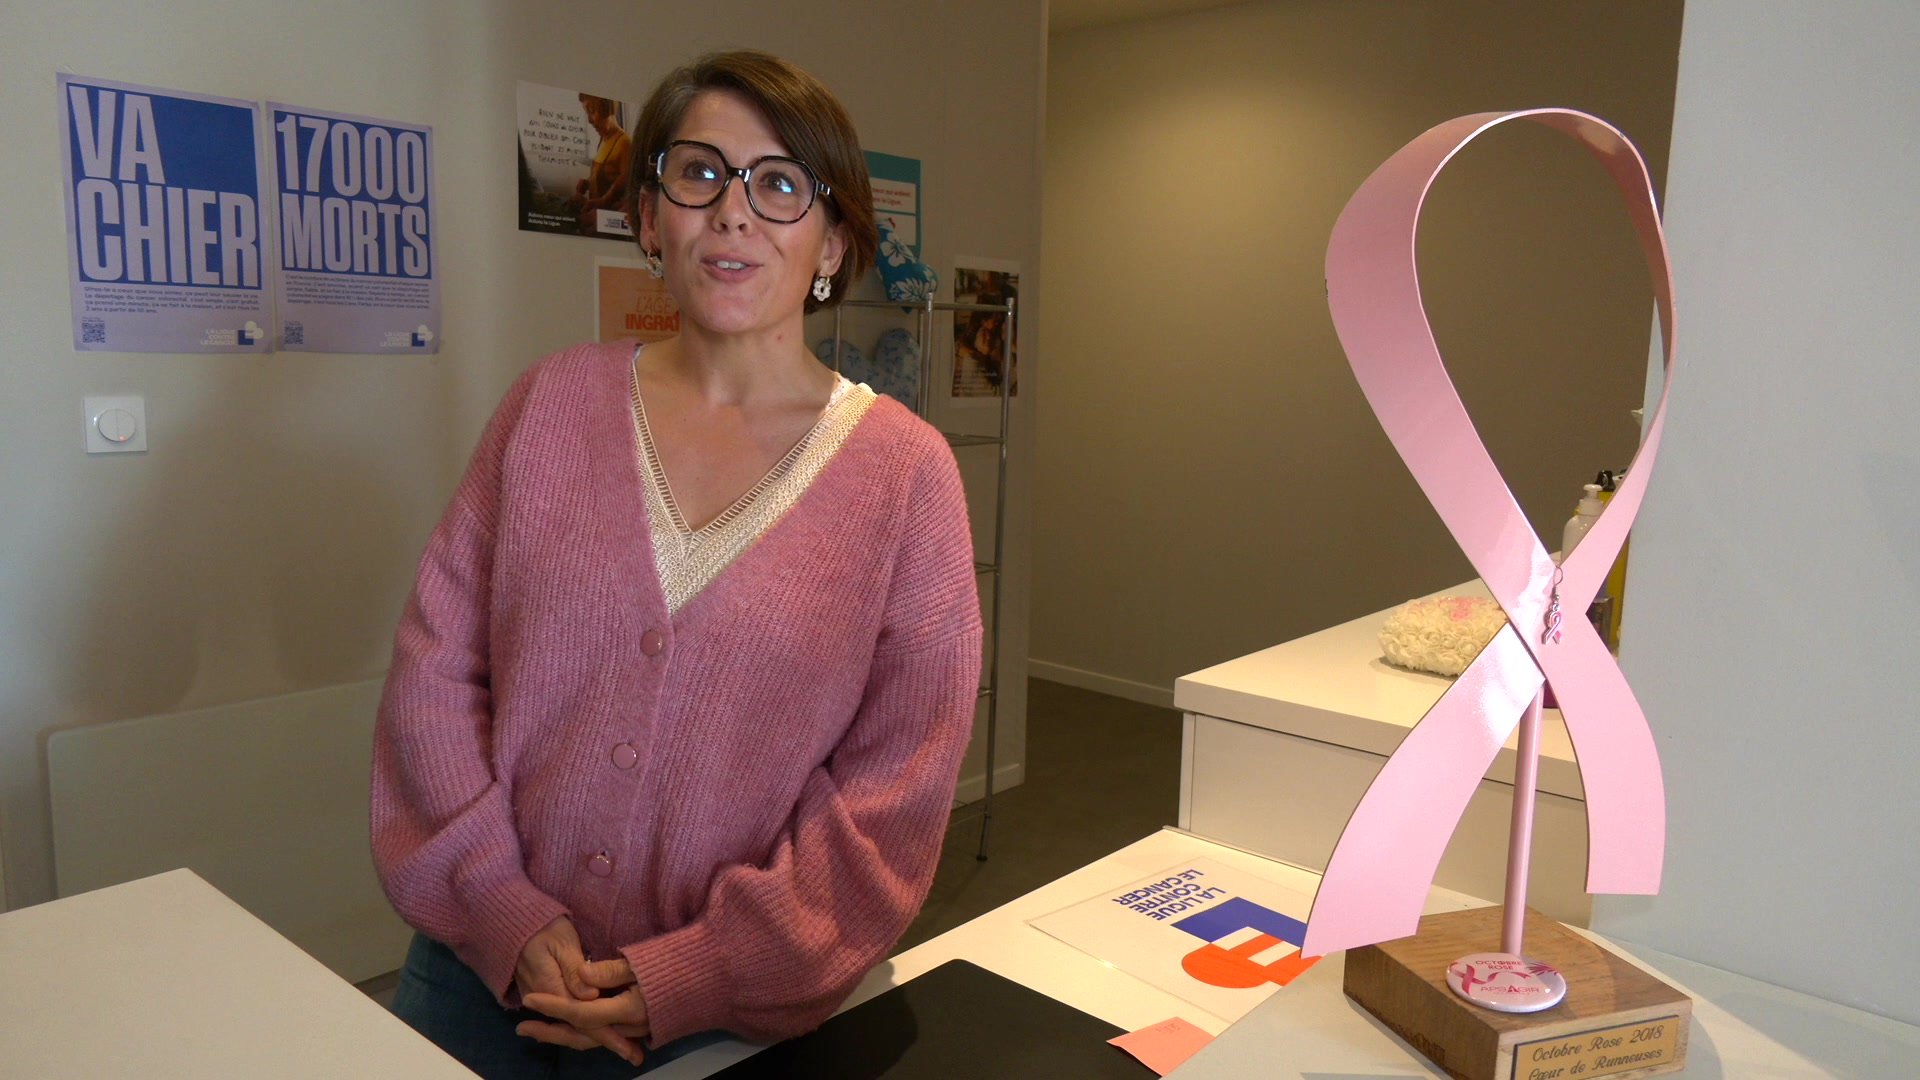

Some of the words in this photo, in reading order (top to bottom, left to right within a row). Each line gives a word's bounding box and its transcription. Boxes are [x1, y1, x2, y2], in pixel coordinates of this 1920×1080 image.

[68, 85, 166, 184] VA
[276, 114, 425, 204] 17000
[77, 178, 259, 287] CHIER
[281, 194, 429, 278] MORTS
[1176, 869, 1204, 880] LE
[1111, 877, 1183, 905] CANCER
[1128, 883, 1201, 913] CONTRE
[1196, 887, 1226, 900] LA
[1145, 896, 1204, 921] LIGUE
[1532, 1043, 1582, 1063] Octobre
[1587, 1036, 1623, 1051] Rose
[1628, 1025, 1665, 1044] 2018
[1570, 1060, 1586, 1075] de
[1591, 1049, 1663, 1071] Runneuses
